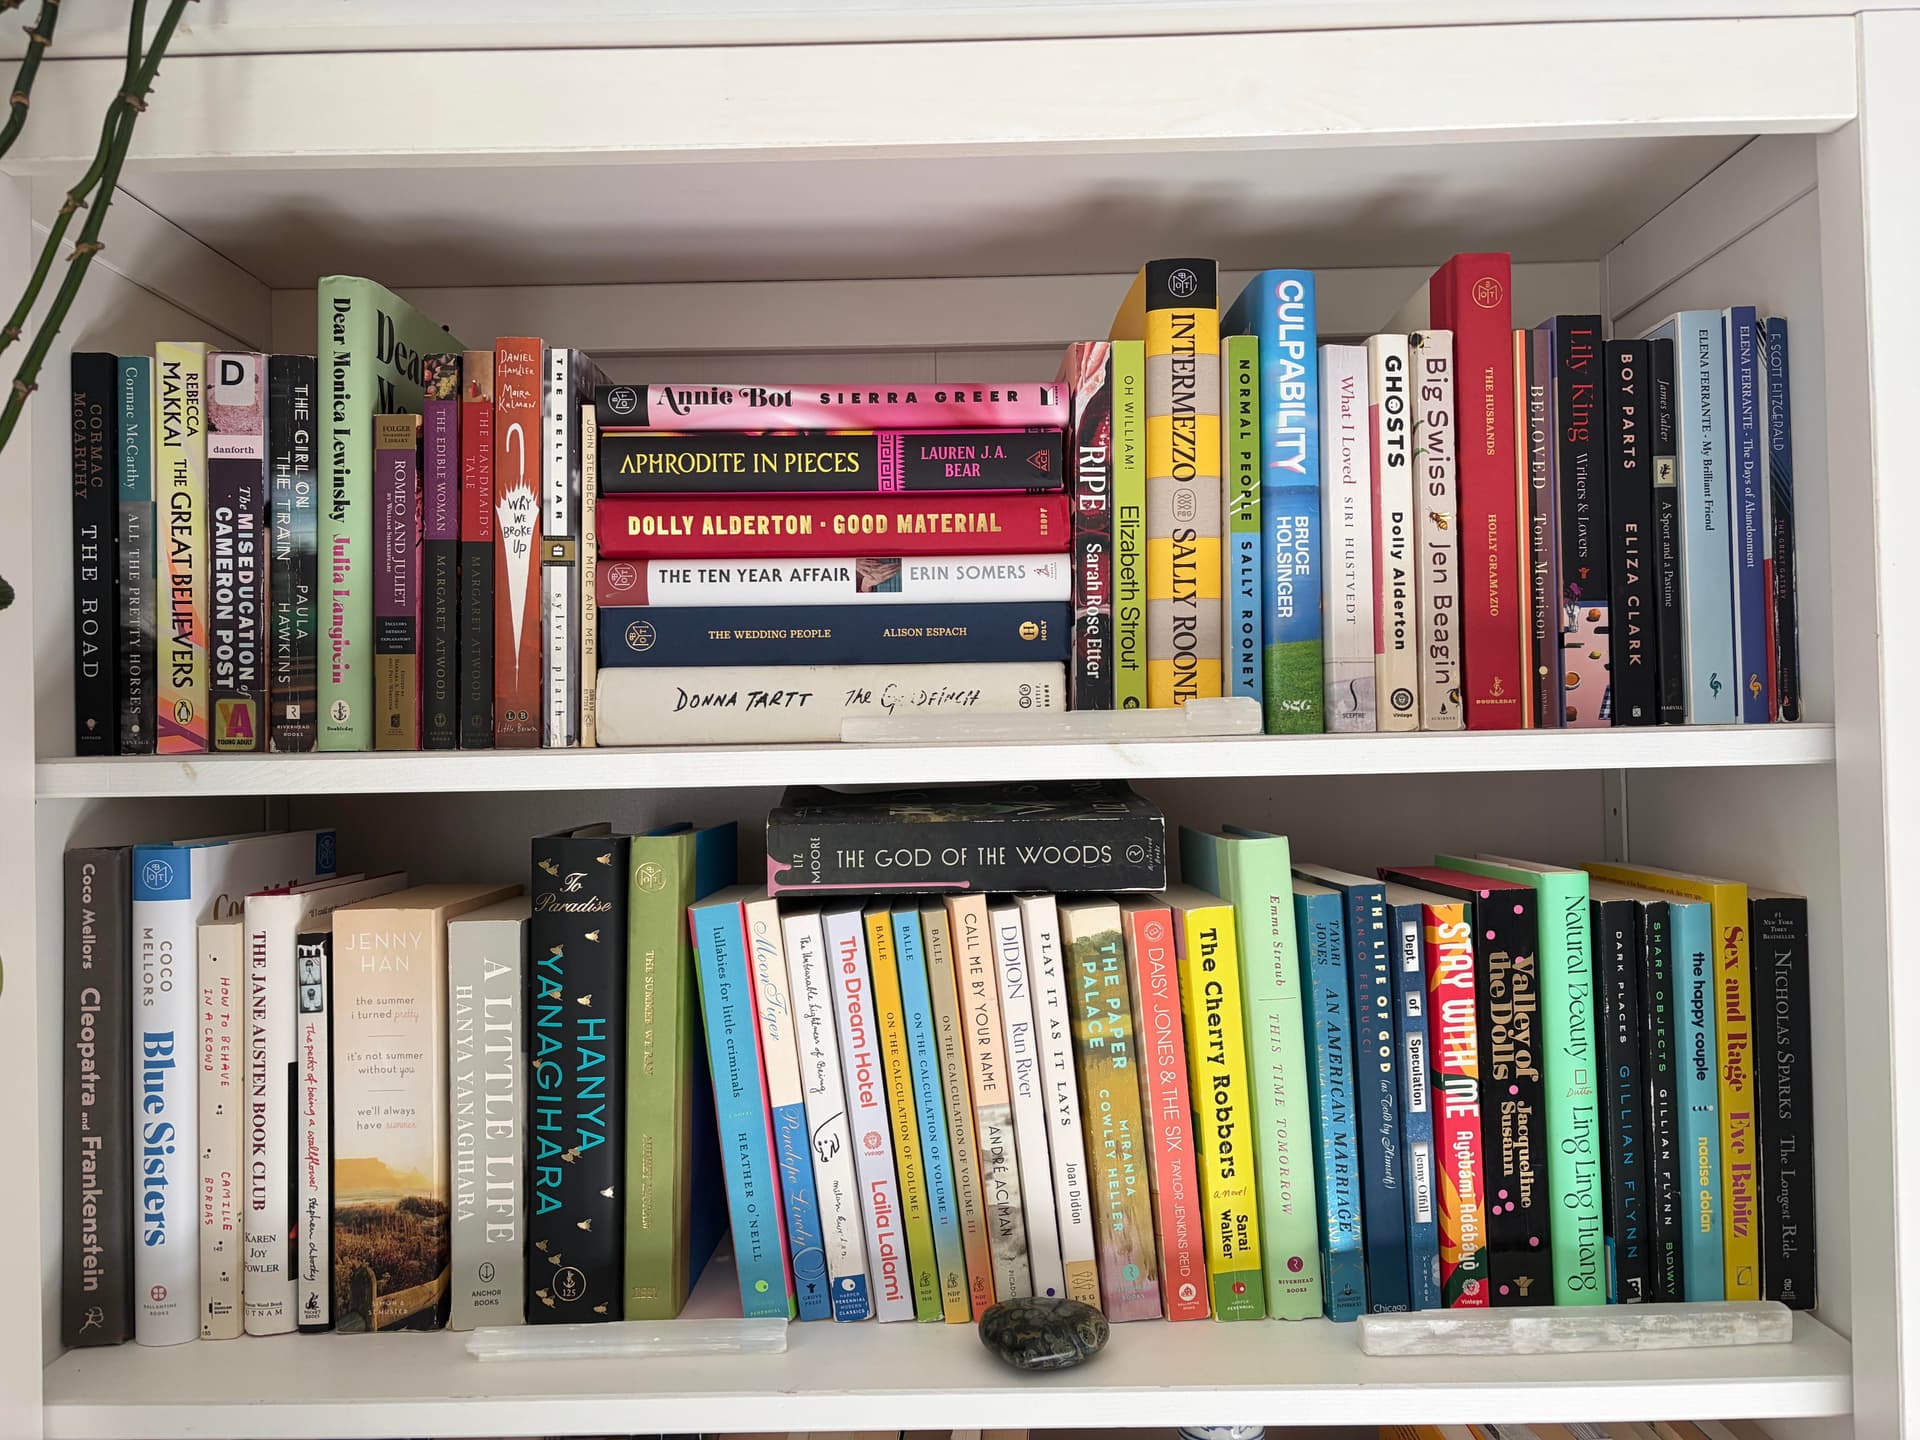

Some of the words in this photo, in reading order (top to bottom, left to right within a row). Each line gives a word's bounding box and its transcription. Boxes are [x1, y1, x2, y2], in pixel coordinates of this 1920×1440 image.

[333, 298, 351, 344] Dear
[221, 360, 245, 386] D
[1566, 330, 1593, 370] Lily
[1699, 330, 1709, 367] ELENA
[125, 367, 137, 419] Cormac
[333, 351, 351, 422] Monica
[820, 392, 918, 404] SIERRA
[935, 391, 1018, 403] GREER
[1172, 313, 1196, 482] INTERMEZZO
[1271, 280, 1306, 475] CULPABILITY
[1422, 358, 1448, 401] Big
[1621, 354, 1634, 395] BOY
[163, 362, 182, 449] MAKKAI
[437, 409, 445, 433] THE
[657, 387, 733, 416] Annie
[739, 388, 793, 407] Bot
[1385, 355, 1404, 467] GHOSTS
[1568, 384, 1594, 442] King
[1700, 371, 1711, 432] FERRANTE
[1772, 383, 1784, 451] FITZGERALD
[124, 424, 139, 490] McCarthy
[213, 445, 255, 455] danforth
[437, 438, 445, 485] EDIBLE
[1428, 411, 1450, 496] Swiss
[1532, 386, 1546, 489] BELOVED
[1622, 406, 1635, 469] PARTS
[174, 459, 187, 487] THE
[277, 454, 291, 490] THE
[329, 429, 351, 523] Lewinsky
[394, 460, 406, 516] ROMEO
[620, 453, 745, 475] APHRODITE
[754, 454, 777, 473] IN
[785, 453, 860, 473] PIECES
[945, 464, 981, 477] BEAR
[1080, 447, 1105, 510] RIPE
[170, 492, 192, 569] GREAT
[277, 498, 290, 560] TRAIN
[437, 491, 445, 531] WOMAN
[628, 516, 694, 535] DOLLY
[702, 515, 813, 535] ALDERTON
[834, 514, 887, 534] GOOD
[897, 513, 1002, 533] MATERIAL
[1344, 497, 1353, 528] SIRI
[1488, 514, 1496, 551] HOLLY
[81, 525, 97, 582] THE
[394, 525, 406, 554] AND
[1120, 506, 1140, 601] Elizabeth
[1391, 512, 1403, 560] Dolly
[215, 508, 233, 618] CAMERON
[392, 557, 406, 607] JULIET
[910, 566, 949, 580] ERIN
[957, 565, 1026, 580] SOMERS
[1241, 542, 1252, 597] SALLY
[1345, 538, 1355, 624] HUSTVEDT
[1489, 554, 1499, 616] GRAMAZIO
[171, 572, 193, 688] BELIEVERS
[883, 629, 922, 637] ALISON
[927, 628, 967, 636] ESPACH
[1393, 568, 1405, 650] Alderton
[82, 599, 99, 678] ROAD
[216, 630, 233, 688] POST
[1121, 607, 1140, 671] Strout
[1242, 610, 1253, 688] ROONEY
[673, 688, 737, 712] DONNA
[746, 691, 813, 711] TARTT
[794, 854, 803, 868] LIZ
[811, 836, 821, 883] MOORE
[836, 850, 864, 868] THE
[875, 850, 932, 868] GOD
[941, 848, 967, 866] OF
[978, 847, 1005, 865] THE
[1016, 846, 1112, 864] WOODS
[82, 864, 95, 903] Coco
[535, 893, 614, 912] Paradise
[560, 872, 588, 893] To
[82, 909, 96, 970] Mellors
[252, 931, 266, 968] THE
[345, 932, 422, 950] JENNY
[840, 936, 857, 974] The
[965, 913, 979, 950] CALL
[1405, 934, 1414, 964] Dept.
[1438, 922, 1473, 988] STAY
[1654, 922, 1663, 980] SHARP
[159, 941, 172, 991] COCO
[361, 955, 409, 973] HAN
[484, 958, 512, 983] A
[970, 956, 983, 975] ME
[1002, 926, 1024, 1000] DIDION
[1101, 943, 1119, 987] THE
[1693, 952, 1704, 976] the
[252, 974, 266, 1020] JANE
[845, 978, 865, 1049] Dream
[972, 981, 985, 997] BY
[1083, 962, 1104, 1048] PALACE
[1410, 998, 1420, 1010] of
[1691, 980, 1706, 1028] happy
[1774, 950, 1792, 1045] NICHOLAS
[975, 1003, 991, 1045] YOUR
[1012, 1022, 1028, 1059] Run
[1107, 998, 1128, 1068] PAPER
[1442, 999, 1477, 1067] WITH
[1656, 991, 1666, 1072] OBJECTS
[143, 1031, 176, 1114] Blue
[252, 1025, 266, 1096] AUSTEN
[485, 997, 513, 1140] LITTLE
[854, 1052, 878, 1109] Hotel
[980, 1053, 996, 1091] NAME
[1017, 1059, 1032, 1098] River
[1411, 1040, 1423, 1105] Speculation
[1694, 1033, 1709, 1081] couple
[536, 950, 563, 1215] YANAGIHARA
[576, 1018, 606, 1151] HANYA
[1445, 1078, 1479, 1118] ME
[1776, 1052, 1794, 1120] SPARKS
[252, 1103, 266, 1155] BOOK
[358, 1107, 380, 1116] we'll
[383, 1107, 416, 1116] always
[1620, 1065, 1633, 1164] GILLIAN
[1730, 1112, 1750, 1154] Eve
[1501, 1101, 1516, 1176] Susann
[1513, 1101, 1534, 1209] Jacqueline
[143, 1123, 175, 1247] Sisters
[252, 1162, 266, 1211] CLUB
[1066, 1163, 1077, 1186] Joan
[1171, 1160, 1184, 1201] TAYLOR
[1415, 1152, 1427, 1183] Jenny
[82, 1136, 103, 1291] Frankenstein
[486, 1154, 514, 1243] LIFE
[738, 1132, 753, 1199] HEATHER
[747, 1204, 762, 1262] O'NEILL
[871, 1181, 891, 1229] Laila
[1068, 1191, 1081, 1224] Didion
[1417, 1185, 1429, 1212] Offill
[1625, 1181, 1637, 1258] FLYNN
[1732, 1164, 1752, 1238] Babitz
[1174, 1203, 1187, 1249] JENKINS
[1220, 1209, 1232, 1259] Walker
[1237, 1215, 1250, 1251] Sarai
[878, 1231, 903, 1301] Lalami
[1179, 1251, 1190, 1277] REID
[1373, 1304, 1407, 1312] Chicago
